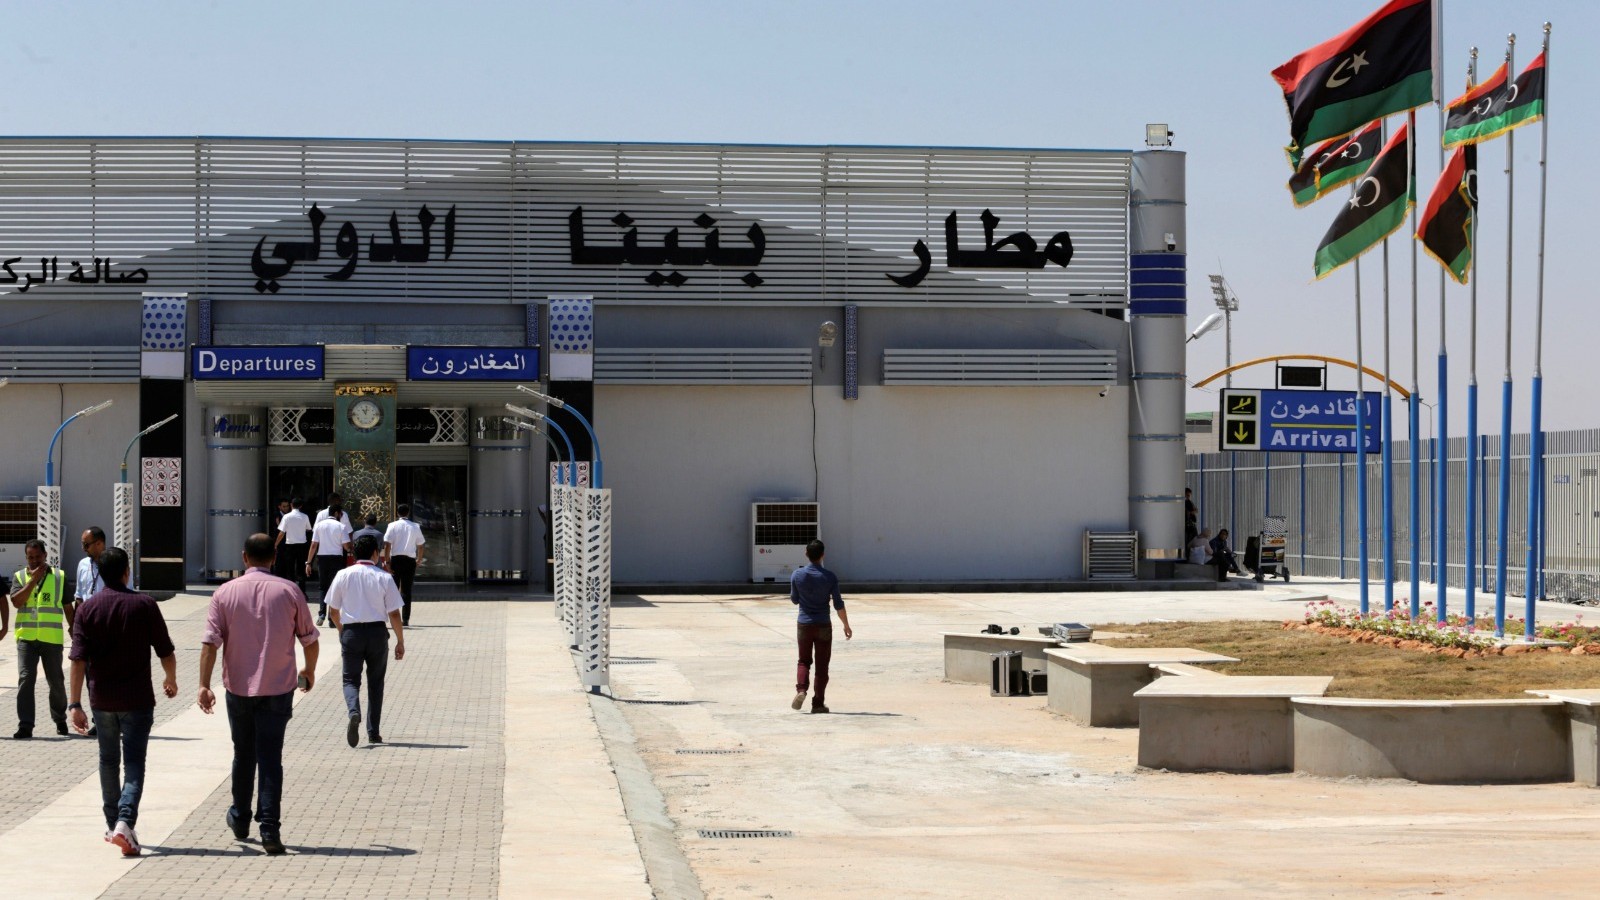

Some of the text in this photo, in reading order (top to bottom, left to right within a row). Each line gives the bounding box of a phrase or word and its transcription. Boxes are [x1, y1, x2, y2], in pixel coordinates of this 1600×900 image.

[251, 202, 1074, 294] مطار بنينا الدولي
[0, 256, 148, 292] صالة الرك
[199, 350, 316, 375] Departures
[422, 353, 526, 374] المغادرون
[1270, 397, 1371, 419] اقادمون
